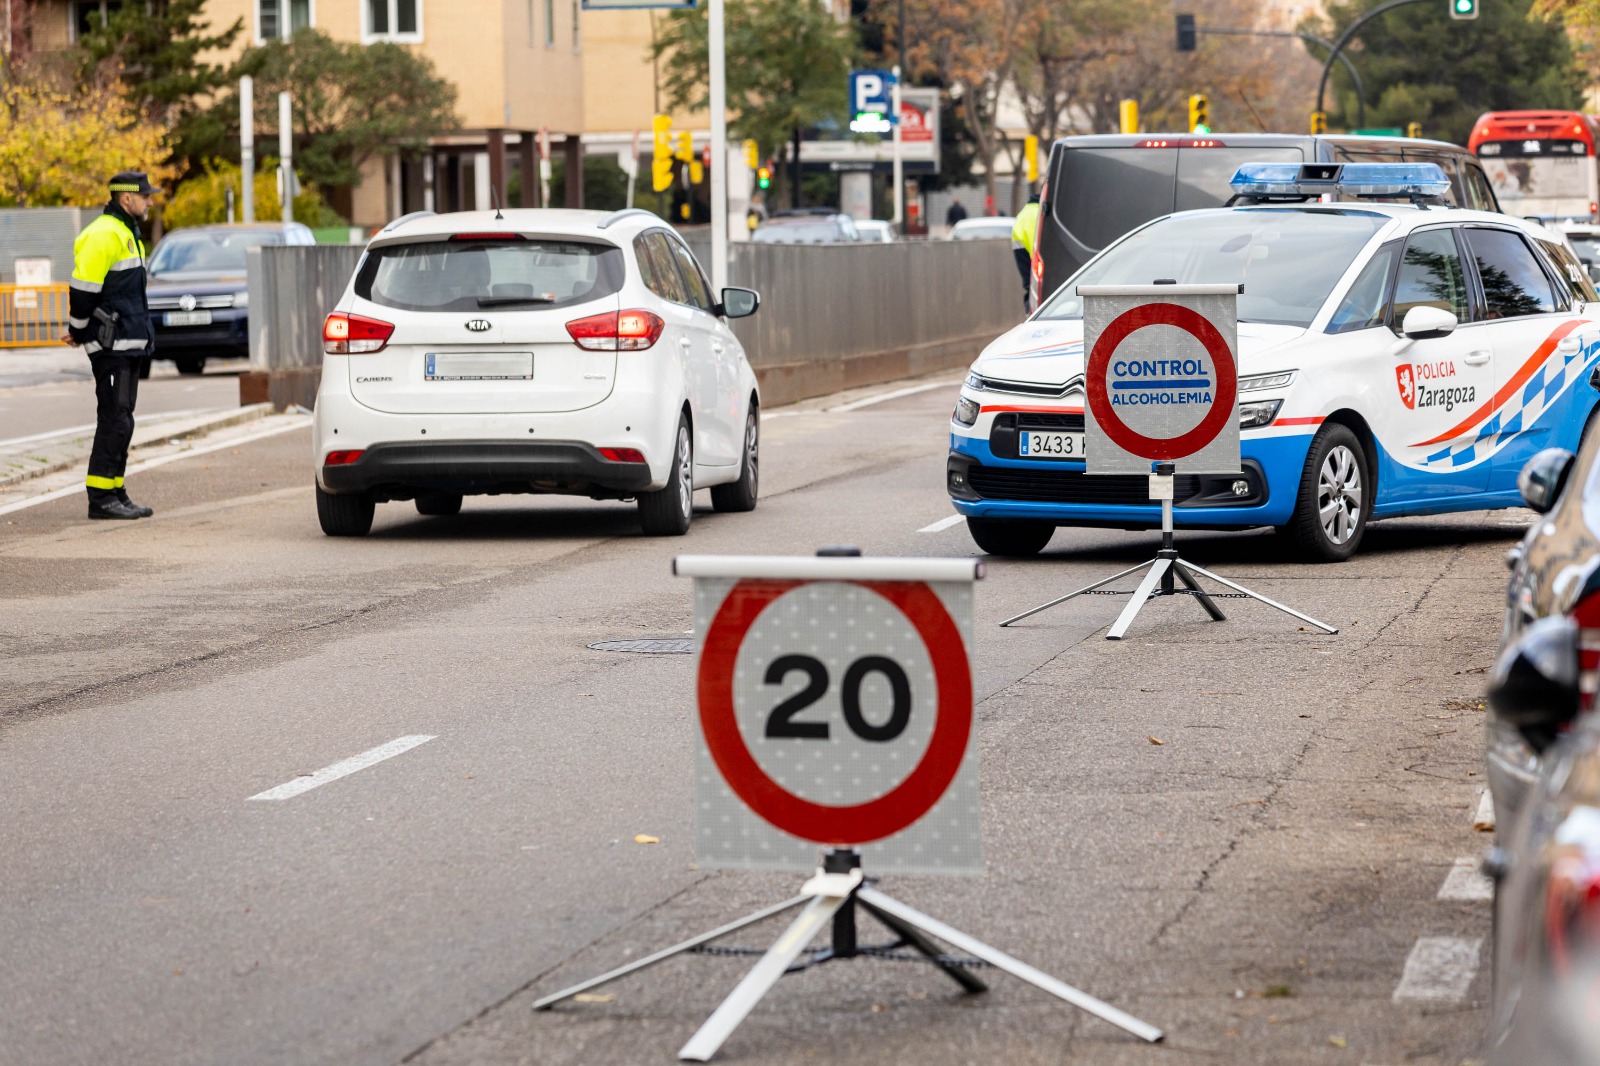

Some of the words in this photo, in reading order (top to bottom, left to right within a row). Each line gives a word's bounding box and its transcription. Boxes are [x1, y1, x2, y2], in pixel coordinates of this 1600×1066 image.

[856, 75, 882, 111] P
[469, 320, 489, 330] KIA
[1113, 359, 1208, 377] CONTROL
[1416, 361, 1456, 380] POLICIA
[1111, 392, 1212, 405] ALCOHOLEMIA
[1418, 385, 1475, 412] Zaragoza
[1032, 435, 1073, 454] 3433
[763, 653, 912, 743] 20
